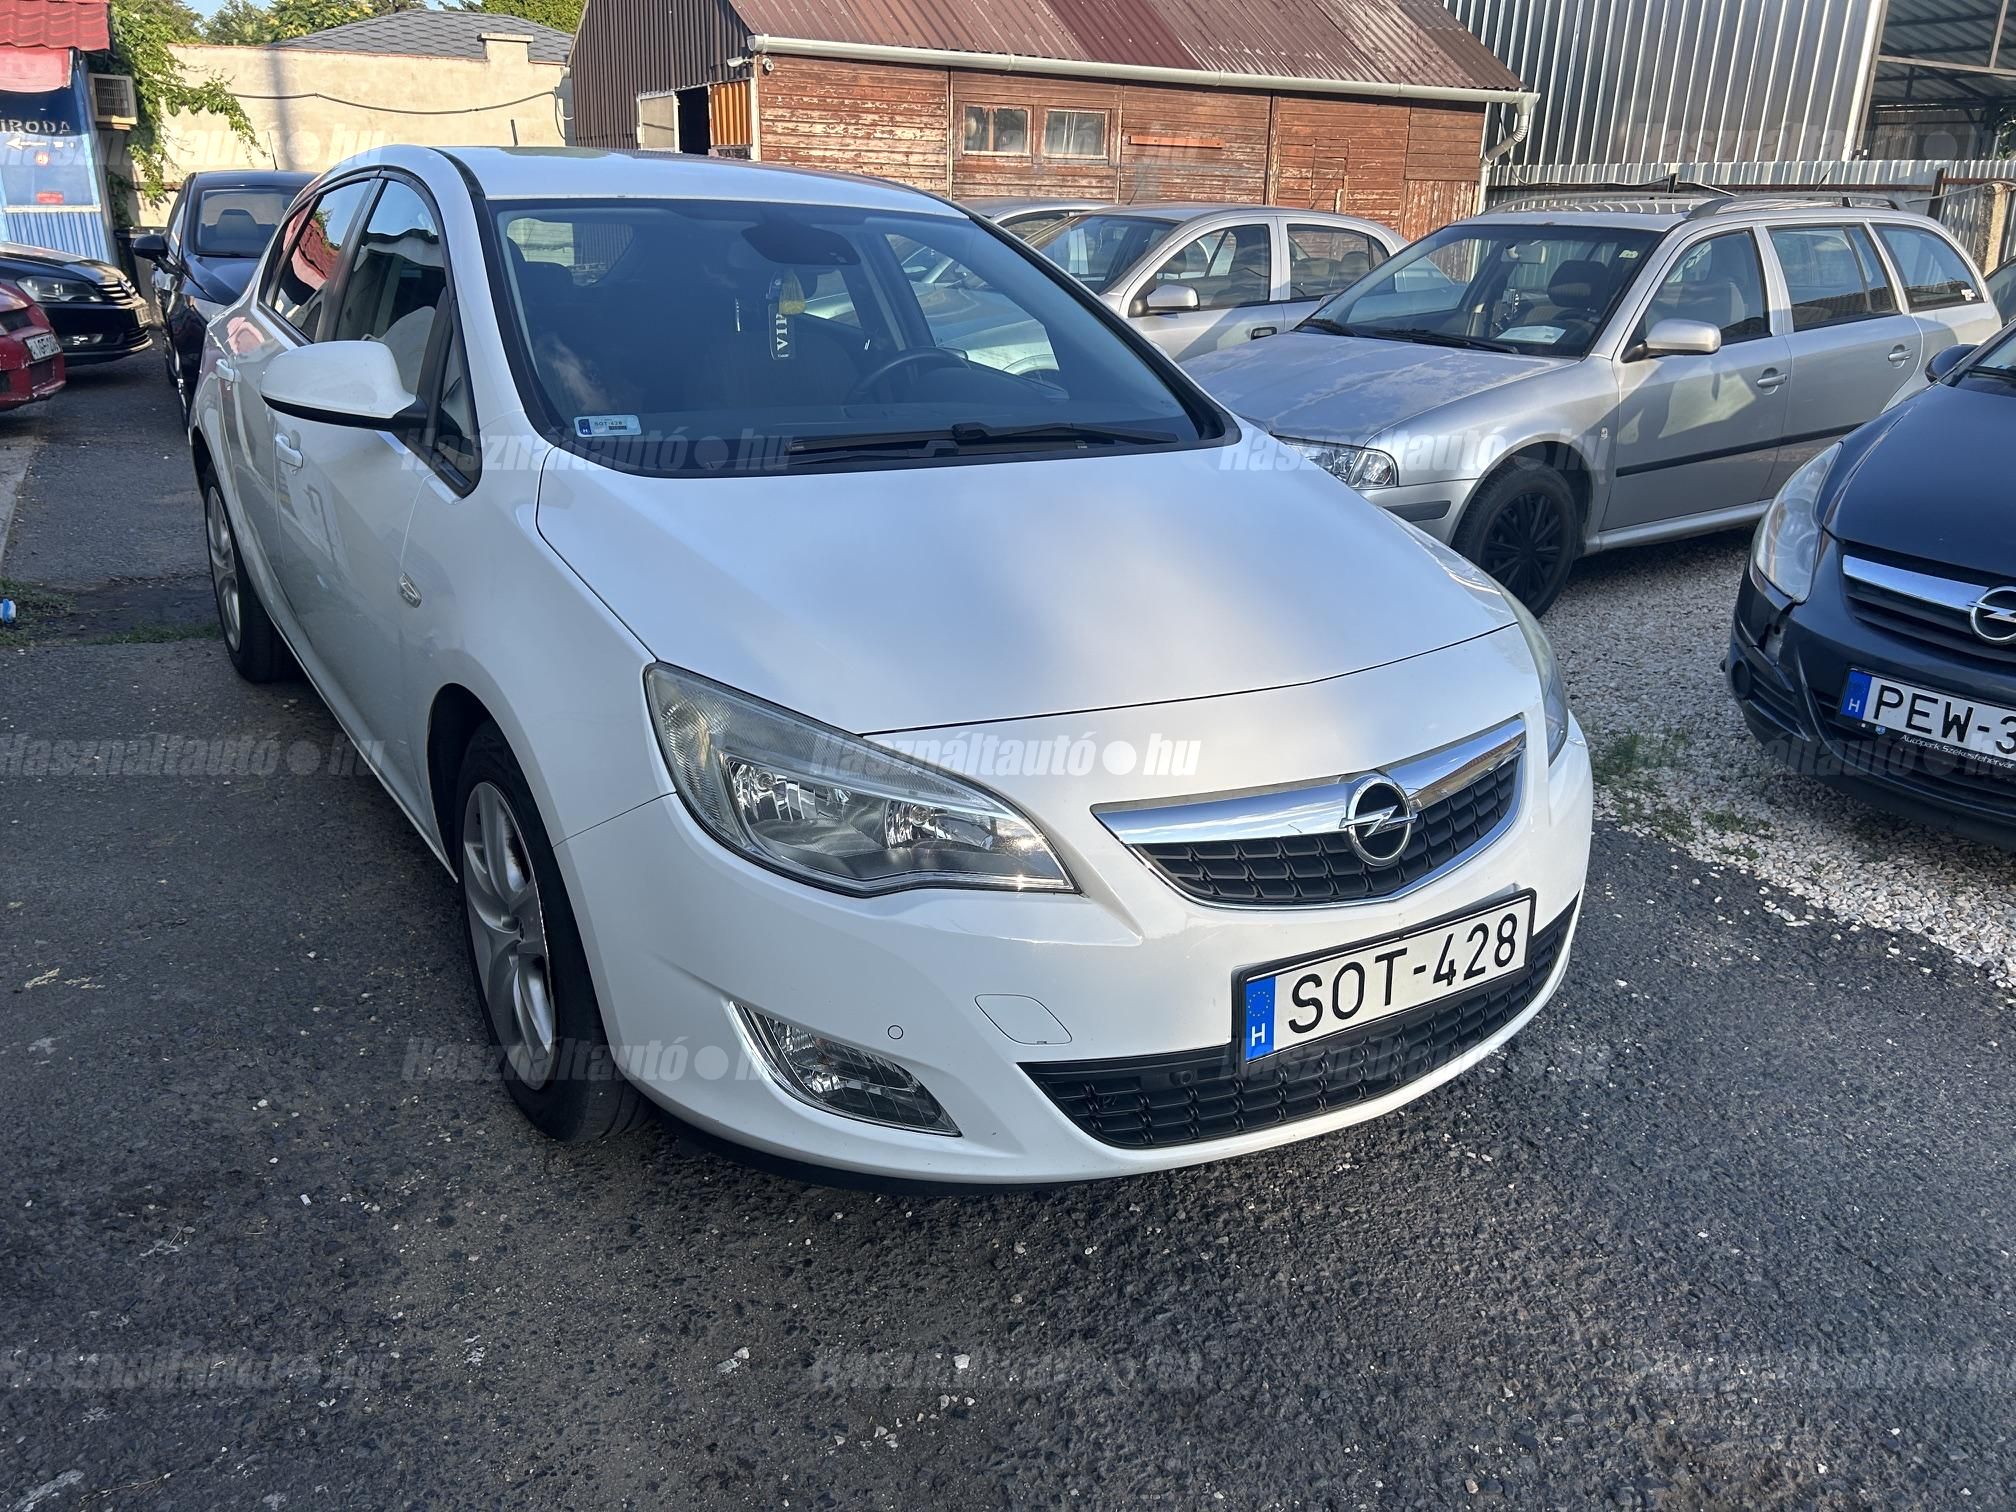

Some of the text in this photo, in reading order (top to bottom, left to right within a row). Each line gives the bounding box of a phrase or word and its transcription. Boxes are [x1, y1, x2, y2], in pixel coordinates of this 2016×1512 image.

[0, 119, 71, 135] IRODA
[1848, 698, 1860, 713] H
[1288, 912, 1518, 1035] SOT-428
[1250, 1022, 1267, 1047] H
